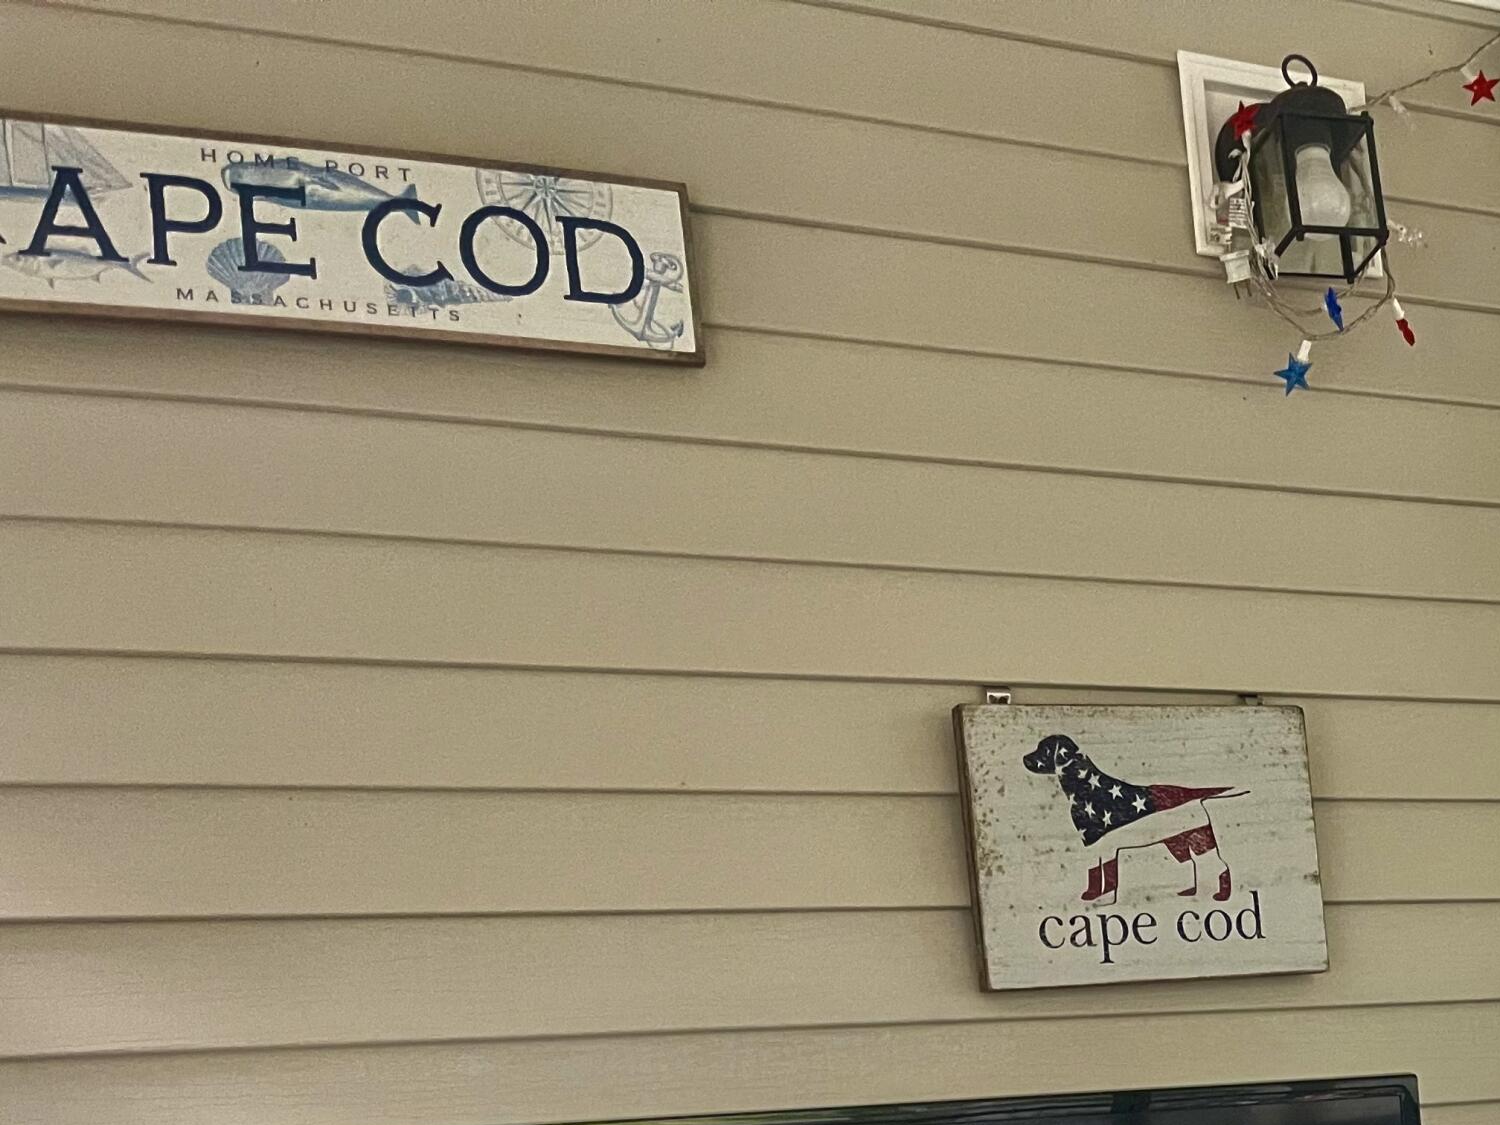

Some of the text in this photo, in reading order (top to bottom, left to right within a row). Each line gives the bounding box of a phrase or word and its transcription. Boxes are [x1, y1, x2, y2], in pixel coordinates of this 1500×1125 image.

[200, 147, 411, 182] HOME PORT
[0, 165, 645, 305] APE COD
[176, 287, 460, 322] MASSACHUSETTS
[1038, 889, 1267, 964] cape cod
